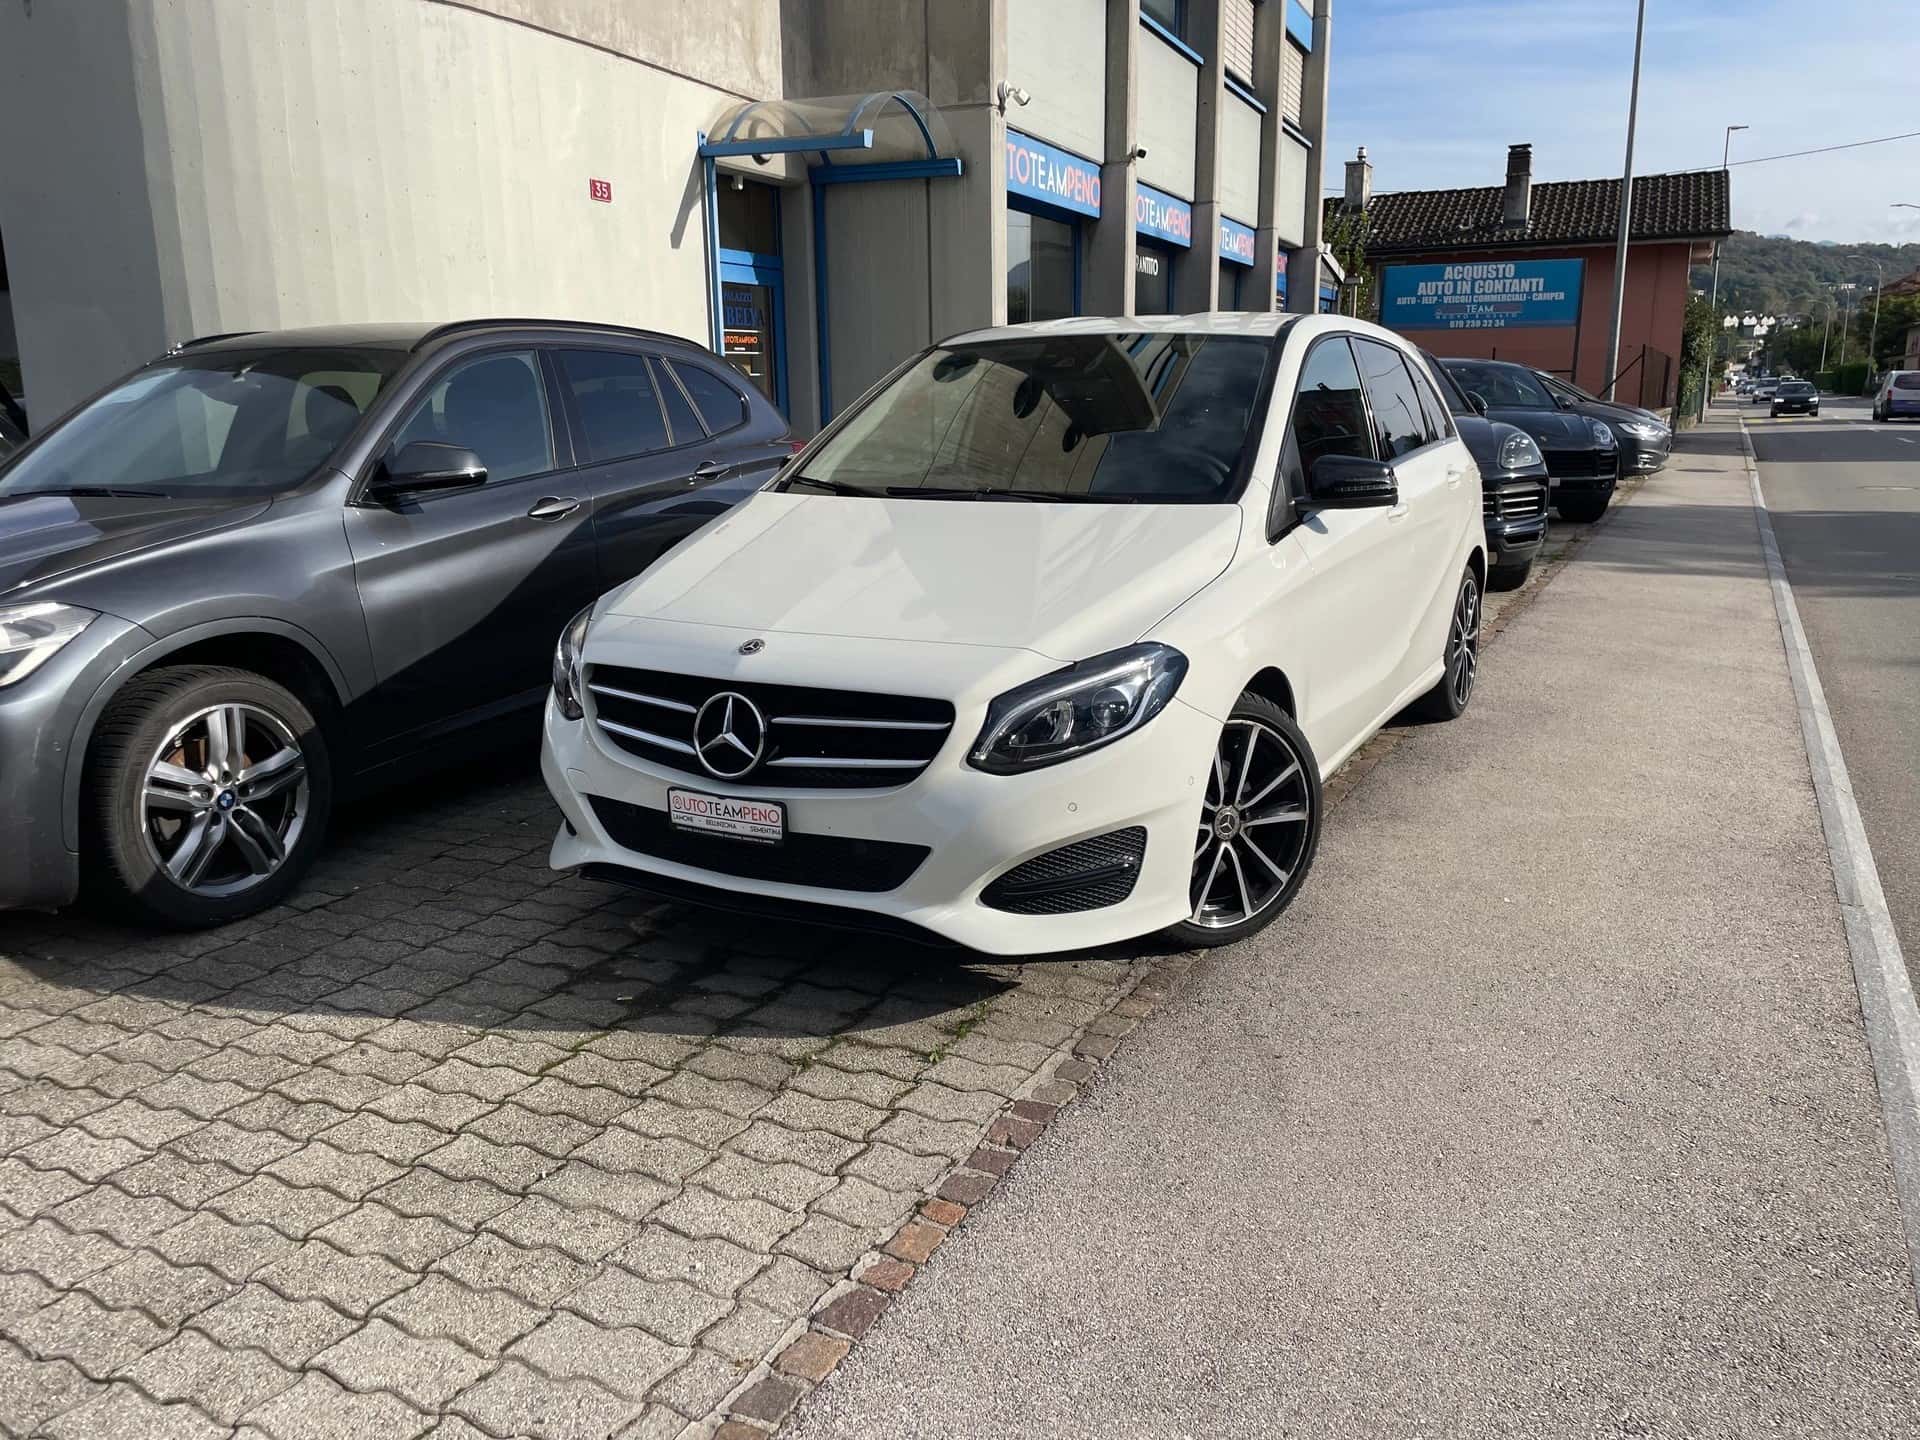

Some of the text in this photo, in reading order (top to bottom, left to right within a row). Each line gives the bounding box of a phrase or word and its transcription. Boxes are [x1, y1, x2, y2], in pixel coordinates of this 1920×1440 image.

[1007, 143, 1100, 207] TOTEAMPENO
[595, 182, 608, 198] 35
[1136, 195, 1191, 238] OTEAMPENO
[1220, 226, 1254, 257] TEAMPENO
[1136, 254, 1158, 276] RANTITO
[1444, 264, 1515, 280] ACQUISTO
[1417, 278, 1544, 295] AUTO IN CONTANTI
[1396, 296, 1416, 304] AUTO
[1421, 296, 1438, 304] JEEP
[1443, 295, 1472, 304] VEICOLI
[1473, 293, 1526, 303] COMMERCIALI
[1532, 292, 1564, 301] CAMPER
[1482, 319, 1493, 327] 32
[1494, 319, 1505, 327] 34
